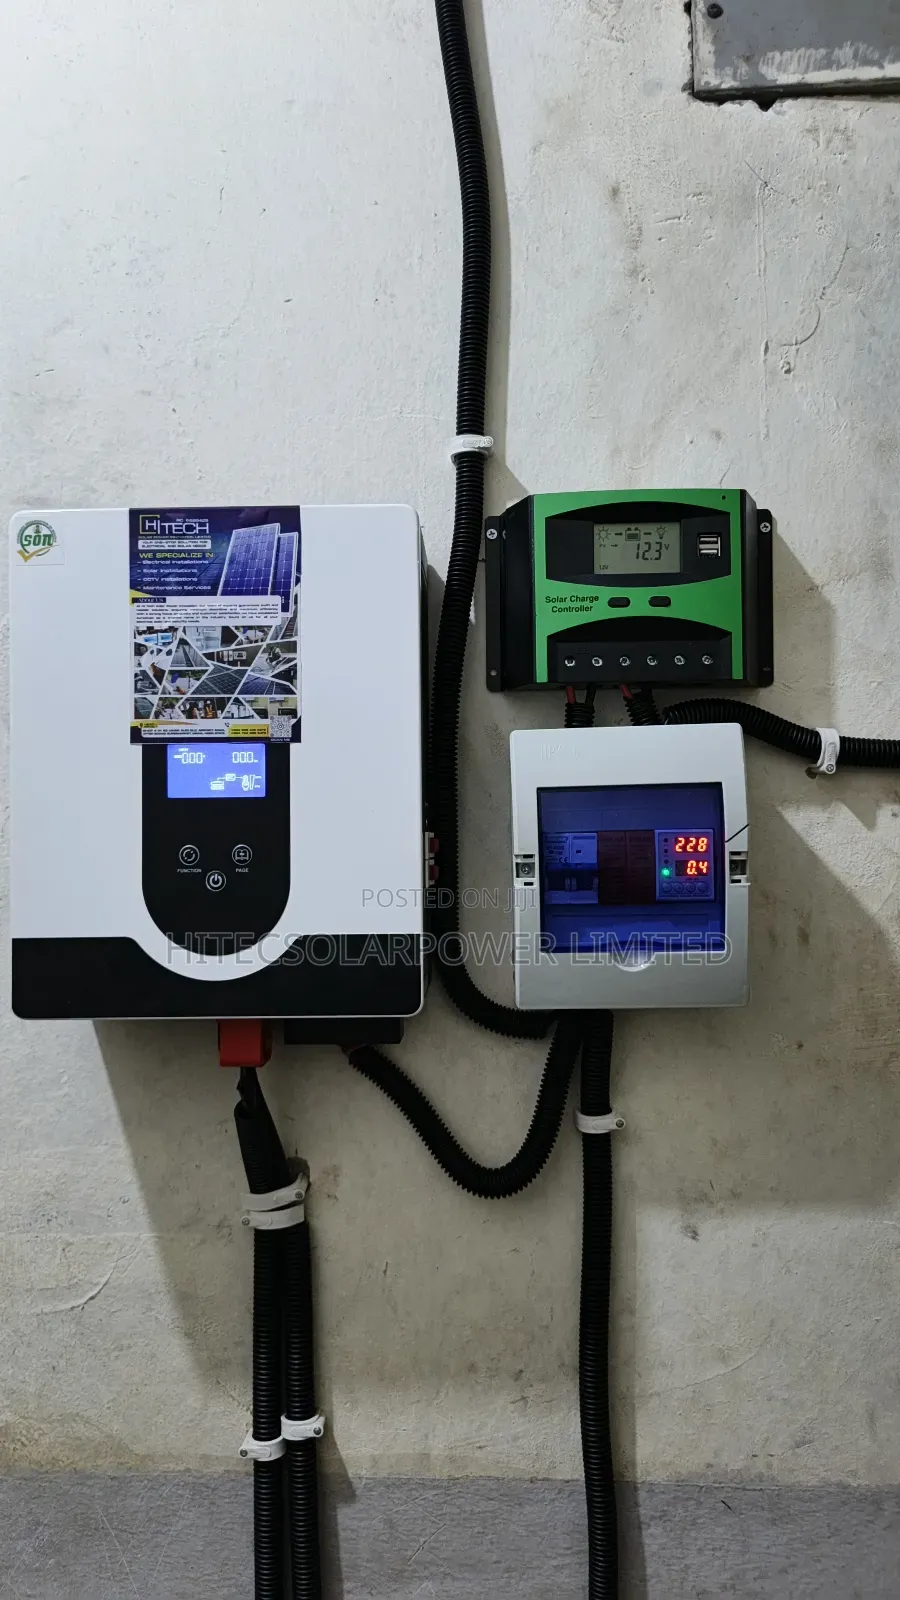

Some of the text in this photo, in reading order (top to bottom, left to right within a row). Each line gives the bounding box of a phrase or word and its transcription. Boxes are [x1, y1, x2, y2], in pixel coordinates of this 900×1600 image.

[551, 605, 593, 613] Controller
[675, 837, 708, 852] 228
[686, 860, 708, 874] 0.4
